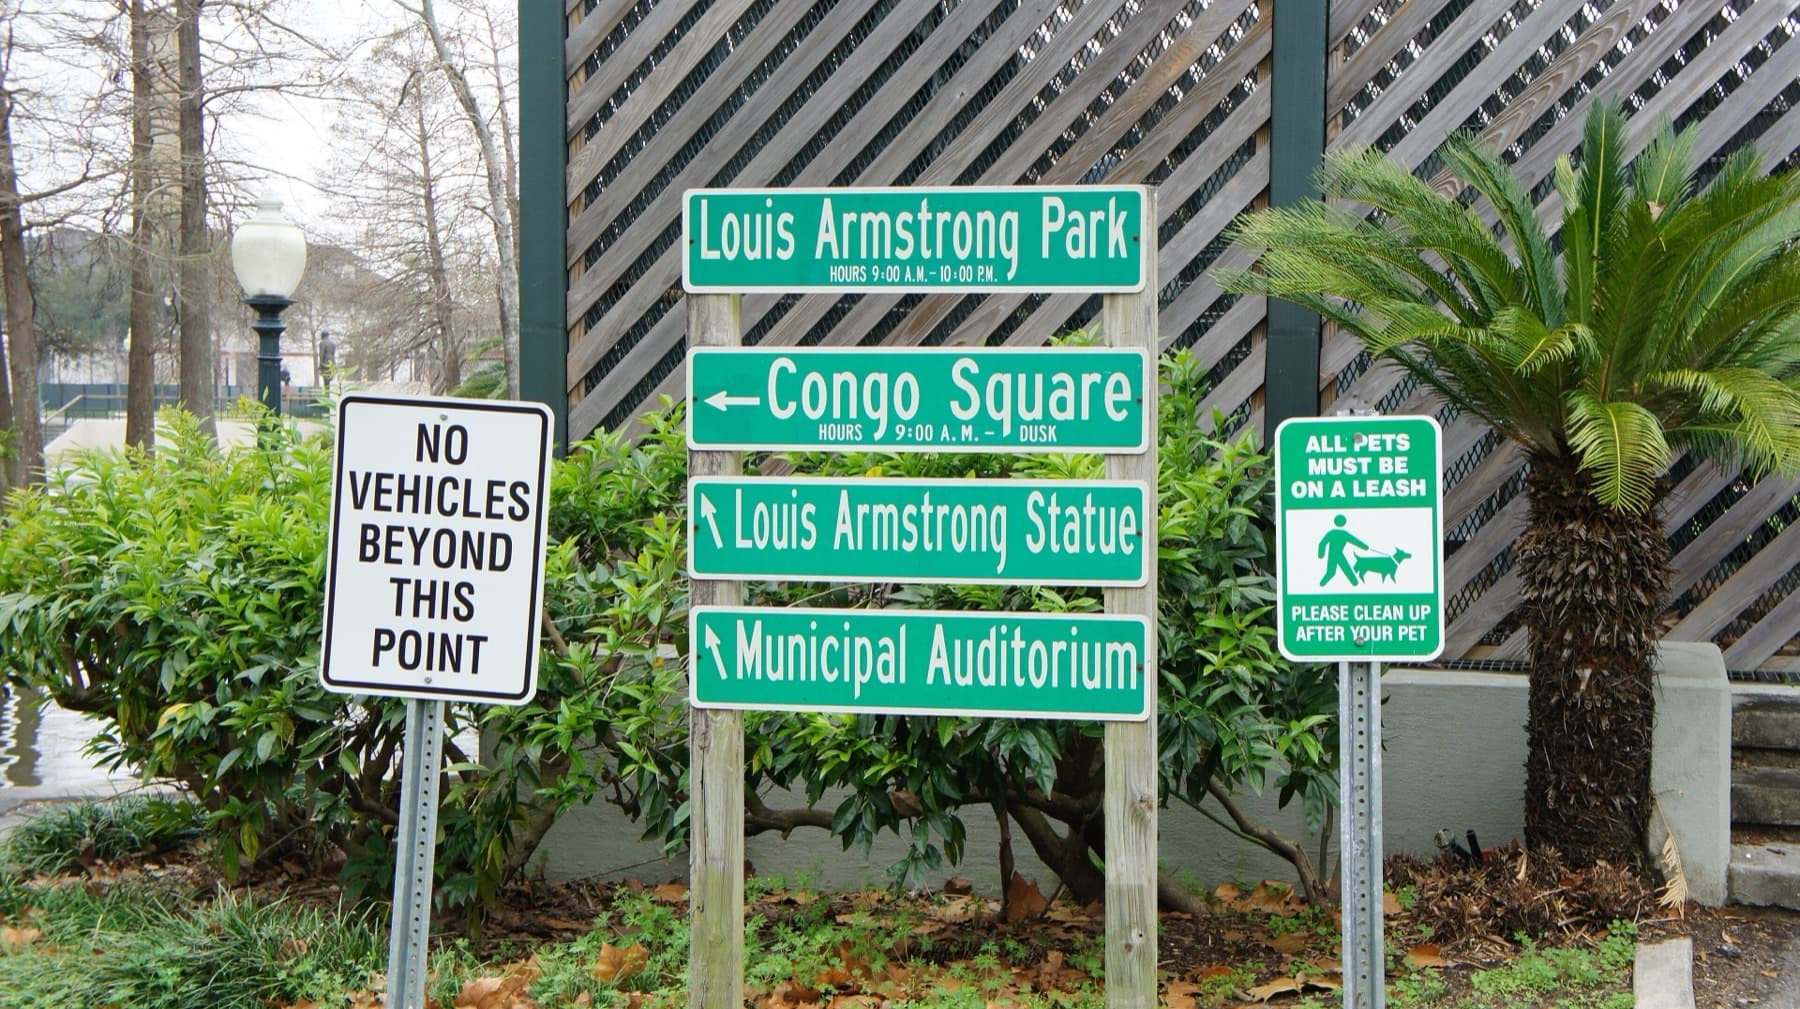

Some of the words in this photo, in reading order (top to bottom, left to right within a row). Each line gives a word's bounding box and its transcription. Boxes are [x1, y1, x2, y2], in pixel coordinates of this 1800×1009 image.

[701, 198, 794, 260] Louis
[816, 198, 1018, 282] Armstrong
[1042, 197, 1127, 258] Park
[831, 266, 866, 281] HOURS
[873, 266, 899, 281] 9:00
[978, 266, 996, 281] P.M.
[768, 357, 921, 441] Congo
[948, 358, 1131, 438] Square
[416, 423, 468, 465] NO
[820, 424, 862, 440] HOURS
[896, 424, 933, 441] 9:00
[1020, 425, 1056, 441] DUSK
[1306, 435, 1346, 452] ALL
[1354, 433, 1410, 451] PETS
[1309, 457, 1371, 475] MUST
[1379, 457, 1408, 473] BE
[349, 470, 529, 521] VEHICLES
[1291, 481, 1323, 498] ON
[1331, 480, 1345, 497] A
[1353, 479, 1426, 497] LEASH
[358, 523, 512, 571] BEYOND
[736, 489, 816, 549] Louis
[834, 490, 1006, 573] Armstrong
[1026, 491, 1136, 554] Statue
[389, 577, 474, 622] THIS
[1292, 606, 1348, 620] PLEASE
[1354, 605, 1403, 620] CLEAN
[1410, 605, 1430, 620] UP
[372, 628, 488, 674] POINT
[1297, 626, 1344, 640] AFTER
[1351, 625, 1392, 641] YOUR
[1399, 625, 1426, 640] PET
[737, 620, 905, 698] Municipal
[927, 624, 1136, 689] Auditorium
